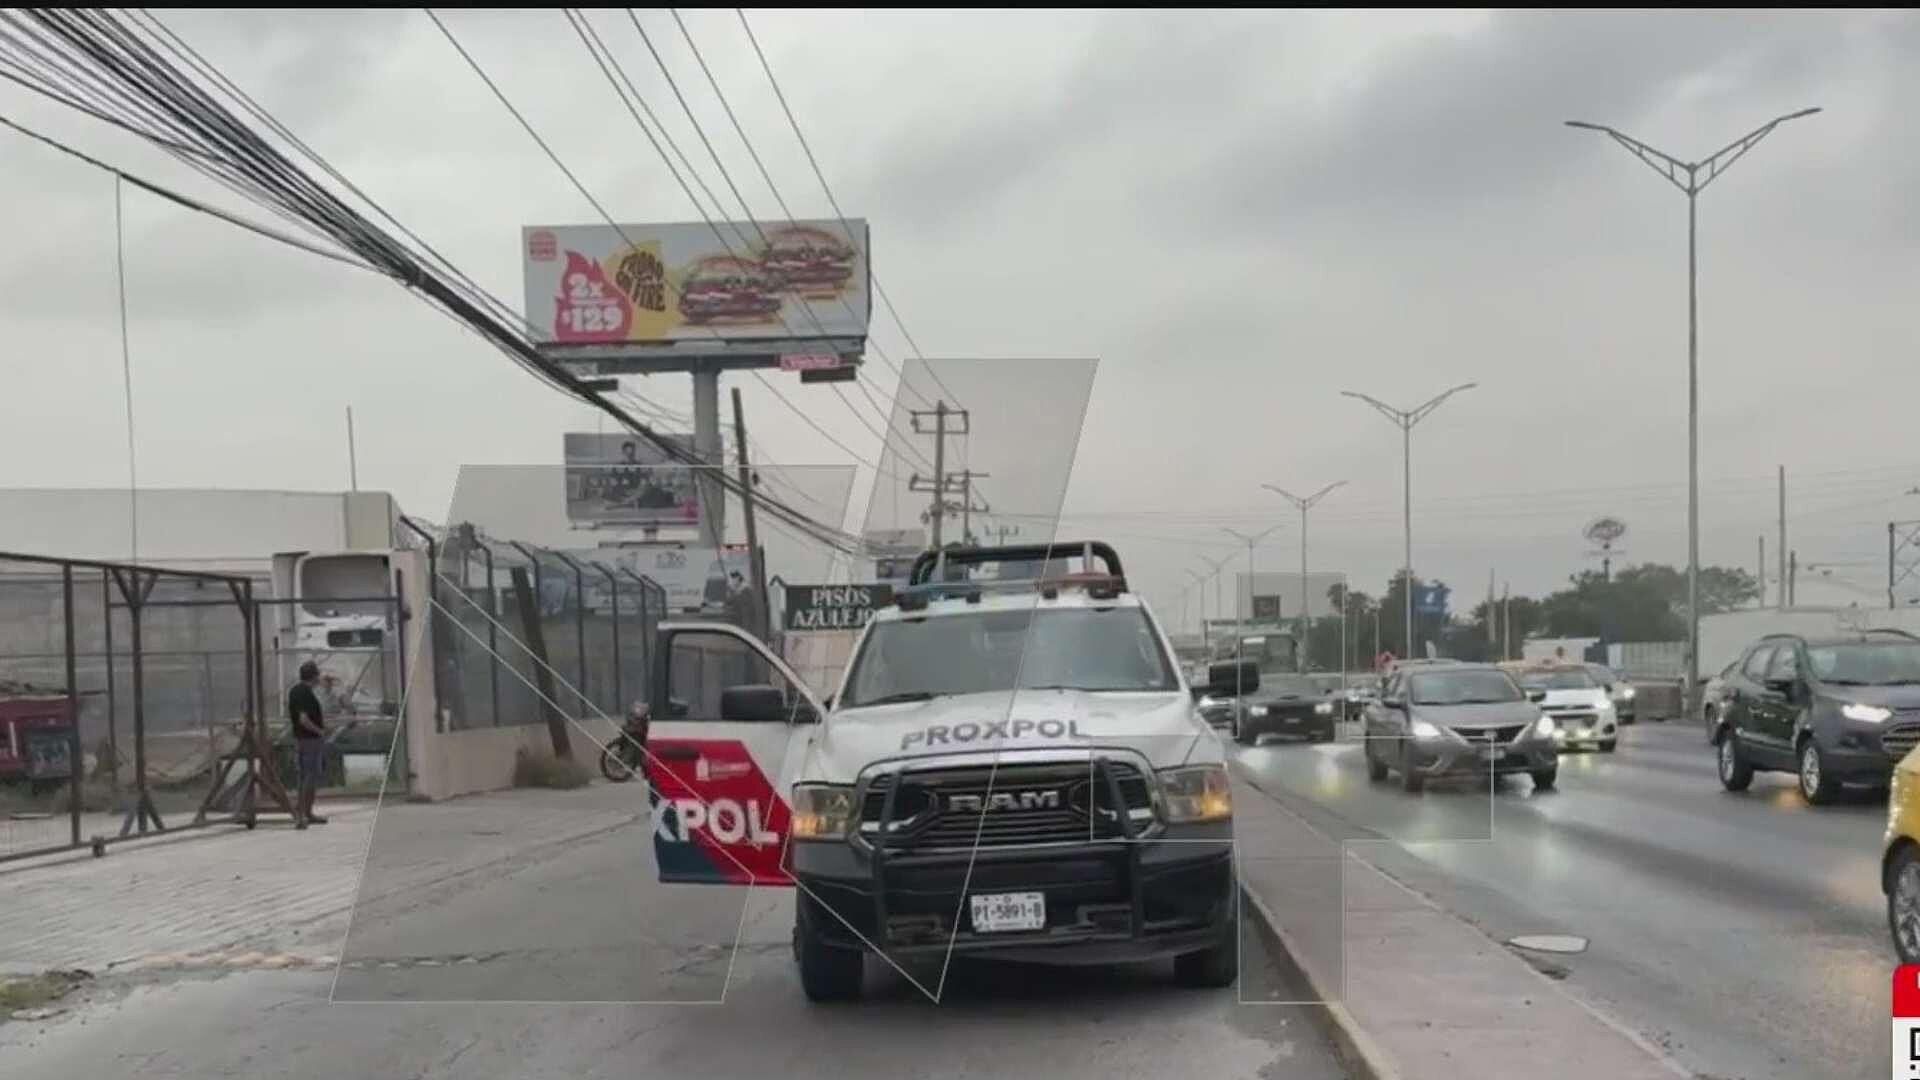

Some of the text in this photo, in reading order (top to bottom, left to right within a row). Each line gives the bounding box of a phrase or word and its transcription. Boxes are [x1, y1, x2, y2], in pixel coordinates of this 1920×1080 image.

[811, 586, 871, 607] PISOS
[902, 719, 1092, 750] PROXPOL
[950, 790, 1059, 811] RAM
